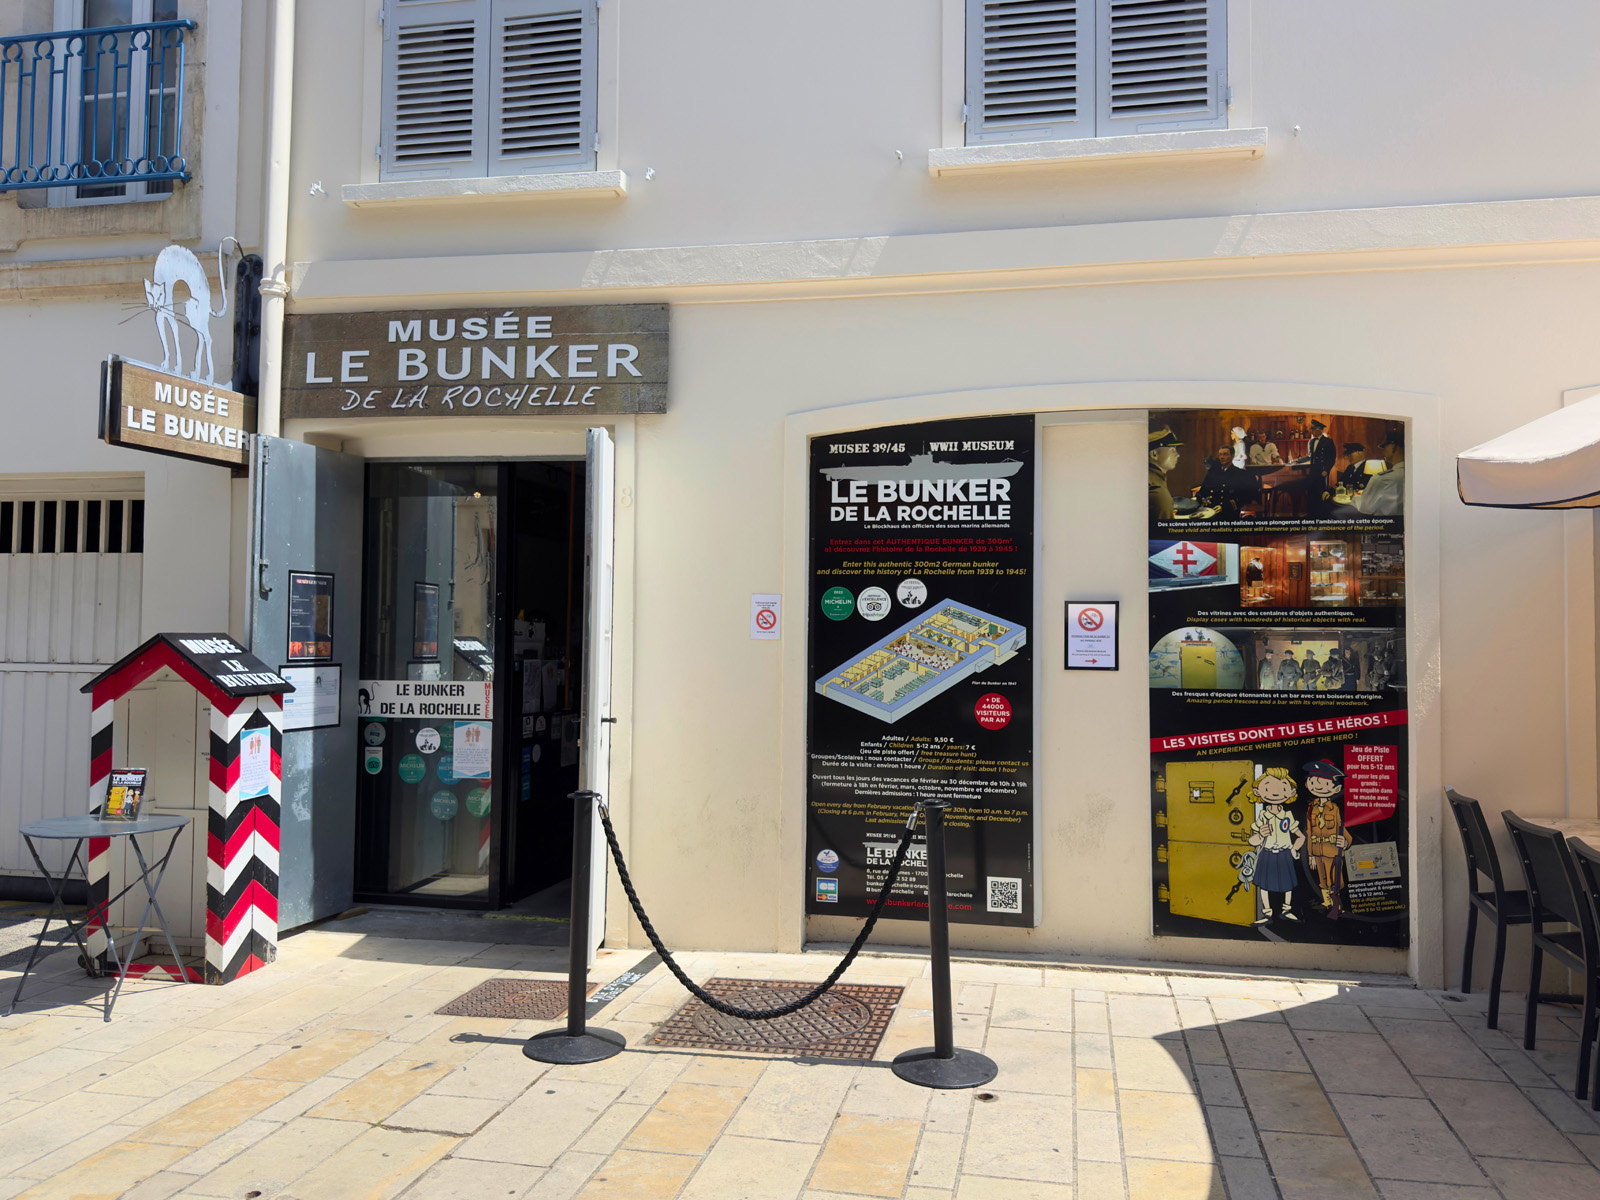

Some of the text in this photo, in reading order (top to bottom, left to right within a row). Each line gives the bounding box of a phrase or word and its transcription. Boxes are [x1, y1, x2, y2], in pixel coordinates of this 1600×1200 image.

[388, 311, 552, 342] MUSÉE
[306, 344, 642, 384] LE BUNKER
[155, 382, 229, 417] MUSÉE
[342, 384, 601, 411] DE LA ROCHELLE
[127, 406, 250, 450] LE BUNKER
[829, 443, 905, 453] MUSEE 39/45
[930, 441, 1014, 452] WWII MUSEUM
[831, 478, 1011, 503] LE BUNKER
[831, 505, 1011, 521] DE LA ROCHELLE
[179, 637, 242, 654] MUSÉE
[221, 660, 249, 671] LE
[216, 672, 286, 688] BUNKER
[397, 684, 464, 696] LE BUNKER
[381, 703, 480, 715] DE LA ROCHELLE
[1163, 715, 1387, 748] LES VISITES DONT TU ES LE HÉROS !
[1209, 745, 1253, 754] EXPERIENCE
